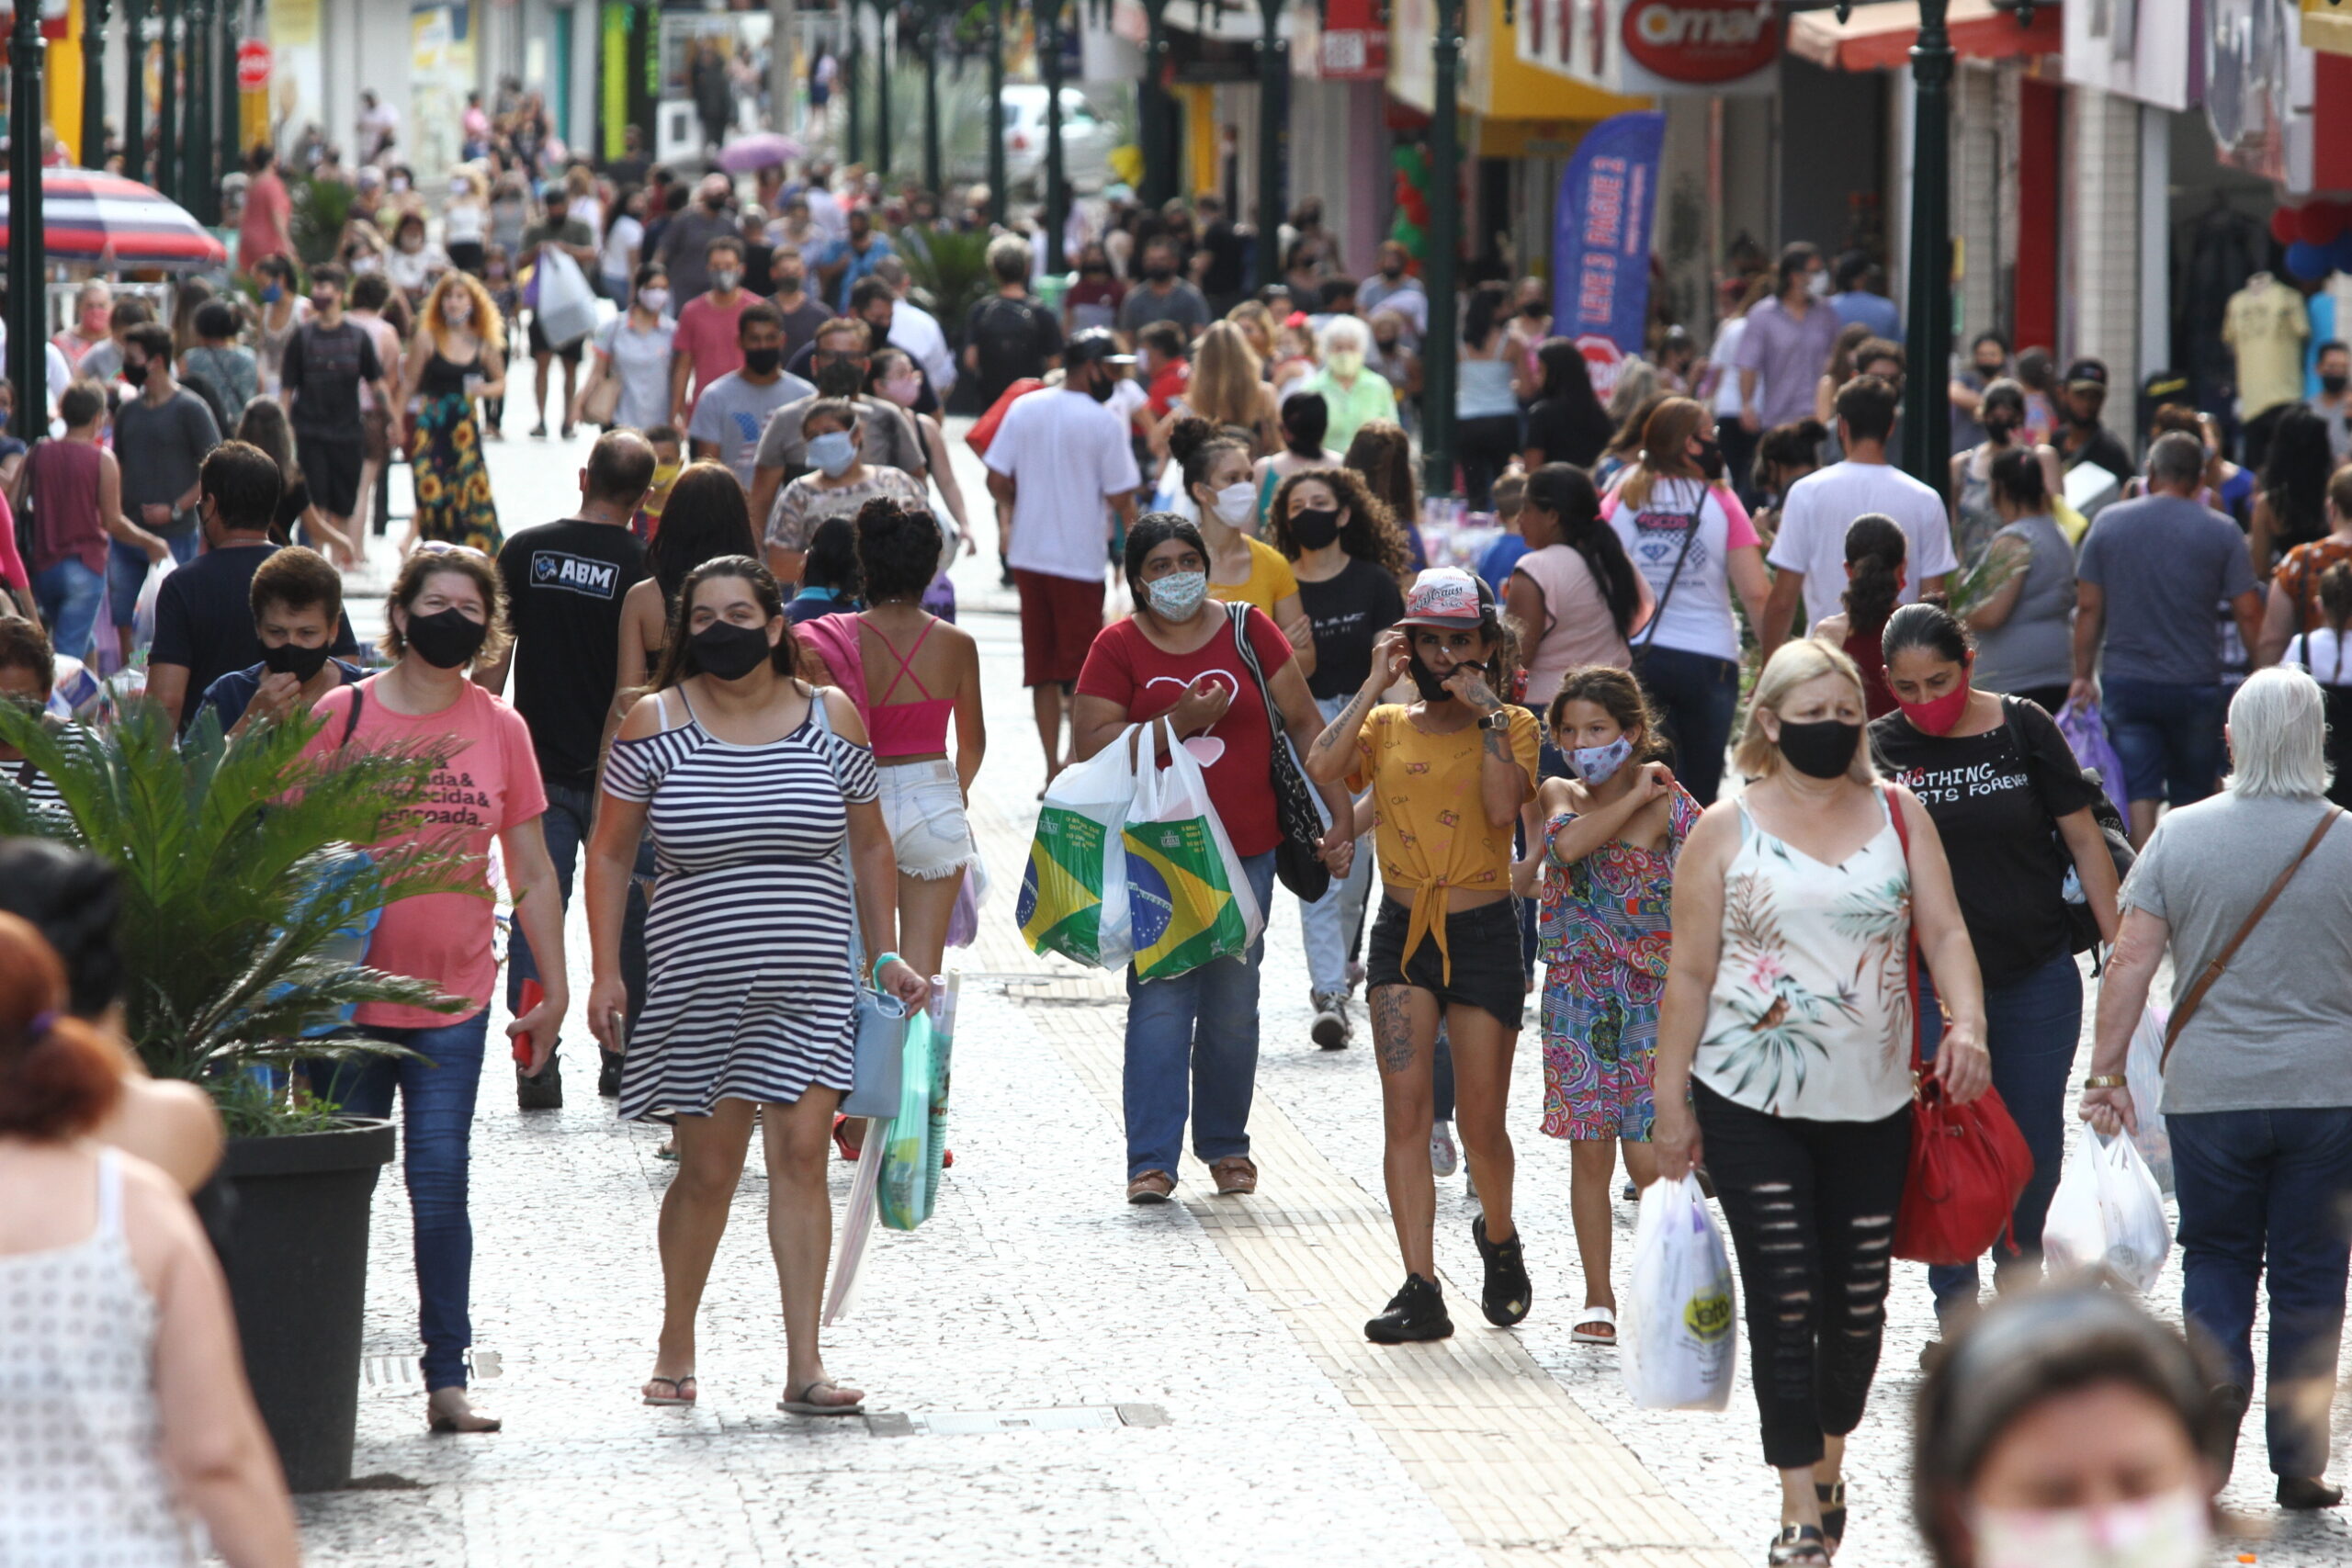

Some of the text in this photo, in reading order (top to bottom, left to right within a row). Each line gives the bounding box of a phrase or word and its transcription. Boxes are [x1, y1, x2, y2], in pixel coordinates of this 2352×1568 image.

[1590, 156, 1626, 175] 2
[1584, 175, 1625, 247] PAGUE
[1583, 252, 1616, 270] 3
[1579, 271, 1614, 323] LEVE
[559, 558, 614, 589] ABM
[1916, 773, 2029, 807] STS FOREVER
